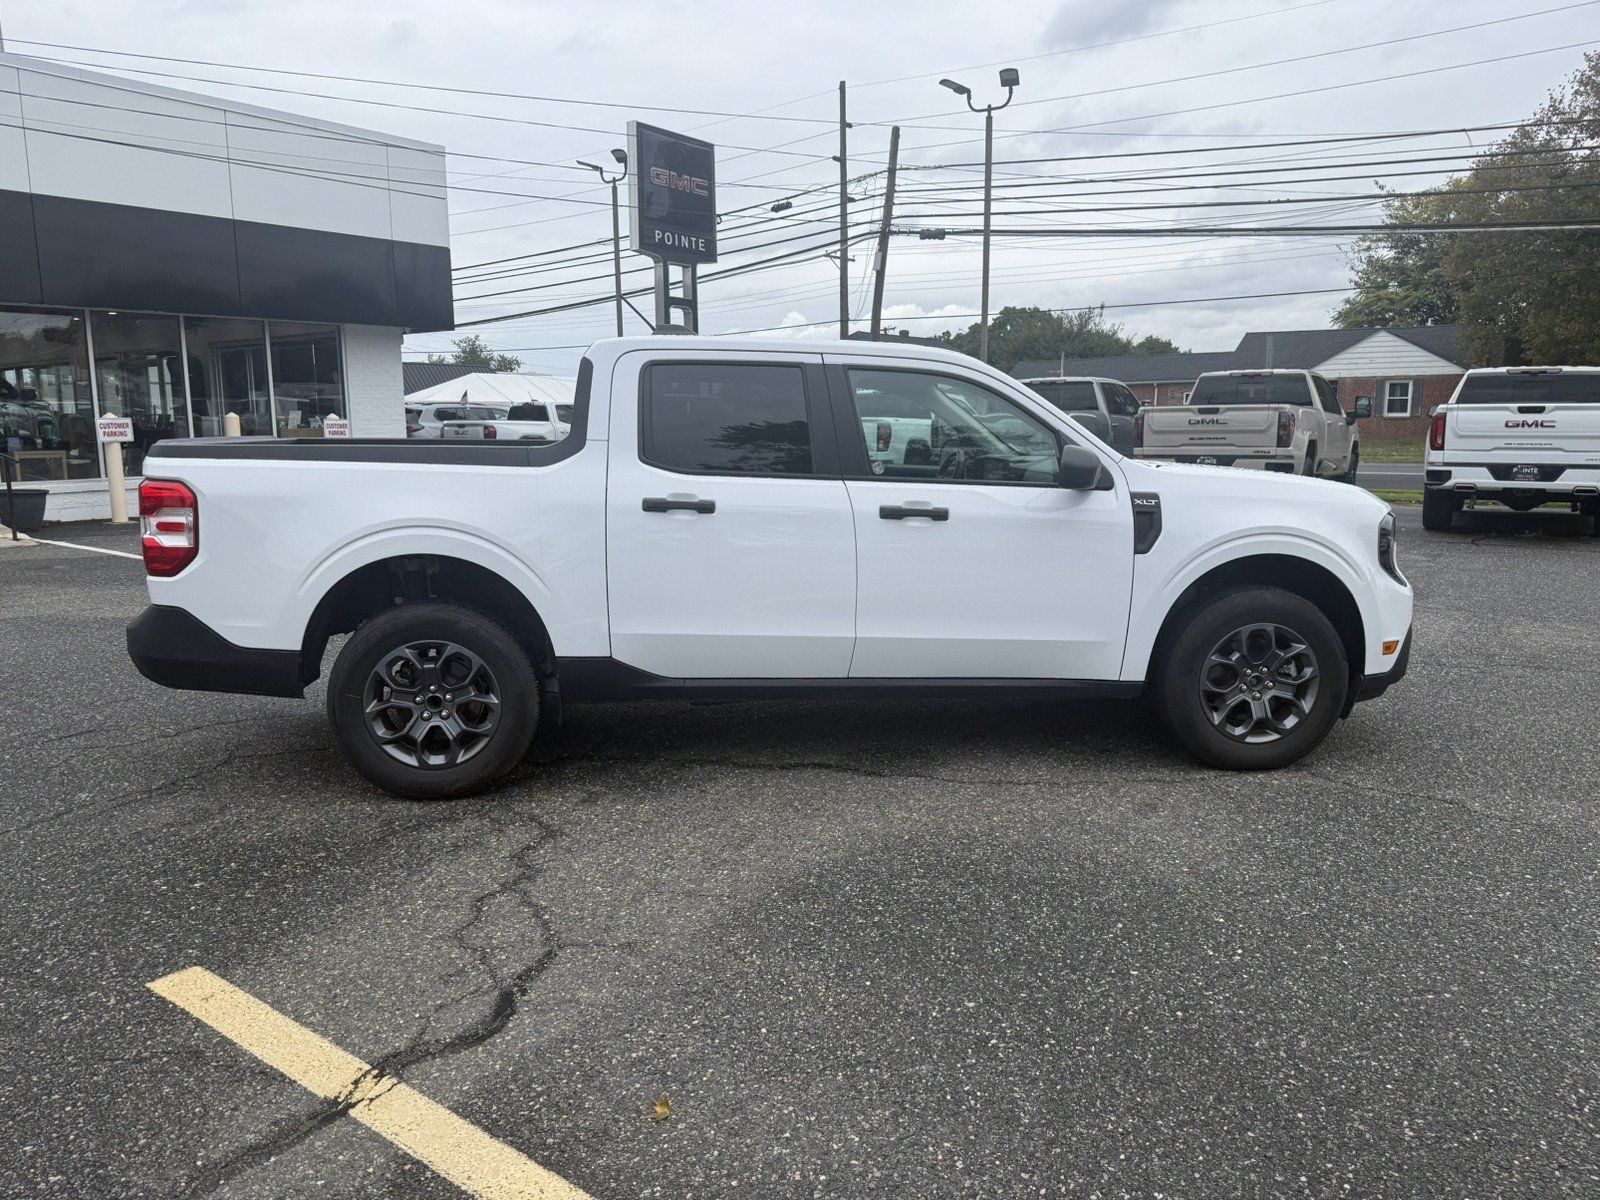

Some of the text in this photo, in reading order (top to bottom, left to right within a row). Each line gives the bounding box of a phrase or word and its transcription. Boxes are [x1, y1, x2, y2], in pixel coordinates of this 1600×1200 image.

[650, 166, 708, 197] GMC
[654, 229, 706, 251] POINTE
[1188, 417, 1229, 425] GMC
[1504, 420, 1556, 428] GMC
[99, 422, 130, 430] CUSTOMER
[326, 422, 349, 430] CUSTOMER
[103, 430, 128, 438] PARKING
